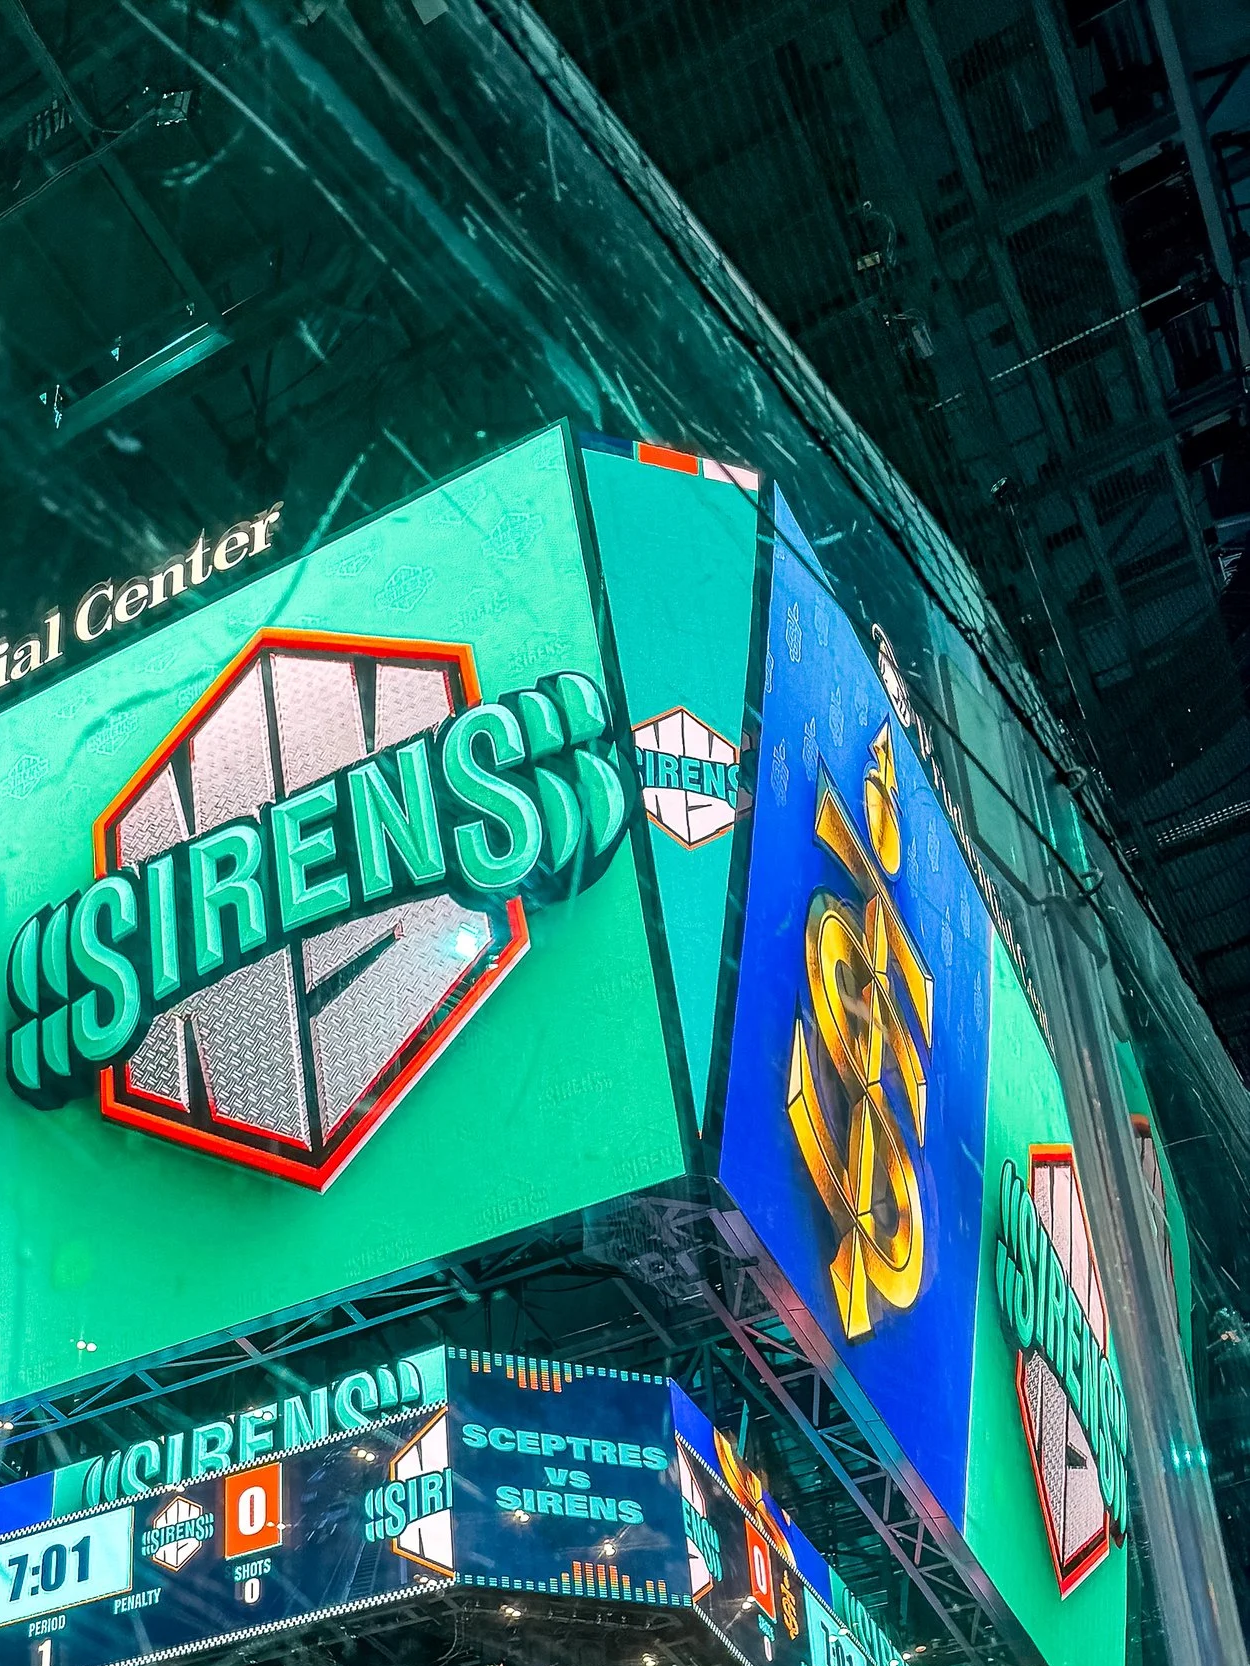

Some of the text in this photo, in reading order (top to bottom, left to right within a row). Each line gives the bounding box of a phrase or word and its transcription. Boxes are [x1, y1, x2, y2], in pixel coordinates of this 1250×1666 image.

[73, 506, 282, 646] Center
[62, 695, 550, 1068] SIRENS
[1012, 1190, 1116, 1510] SIRENS
[461, 1423, 669, 1471] SCEPTRES
[544, 1466, 592, 1490] VS
[237, 1486, 268, 1536] 0
[496, 1486, 645, 1525] SIRENS
[149, 1515, 207, 1554] SIRENS
[8, 1535, 92, 1603] 7:01
[234, 1557, 272, 1583] SHOTS
[113, 1587, 162, 1615] PENALTY
[244, 1577, 261, 1604] 0
[28, 1614, 66, 1638] PERIOD
